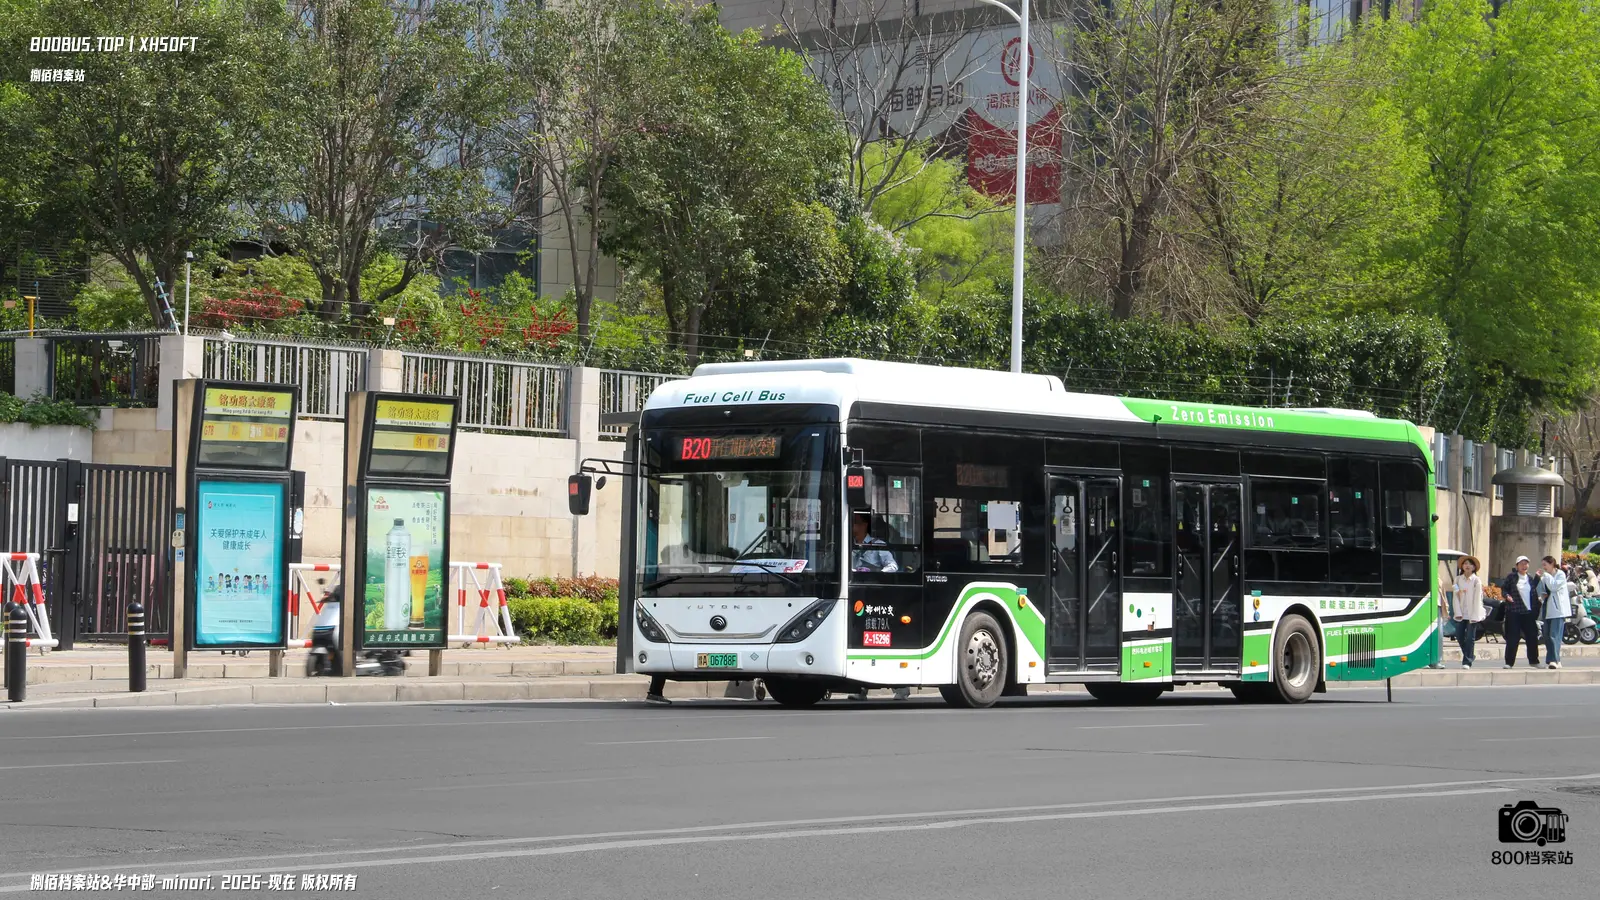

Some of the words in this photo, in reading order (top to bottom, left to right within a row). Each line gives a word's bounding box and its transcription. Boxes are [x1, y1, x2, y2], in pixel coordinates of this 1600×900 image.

[218, 393, 276, 409] 铭功路太康路
[683, 392, 717, 404] Fuel
[722, 390, 754, 402] Cell
[758, 390, 786, 401] Bus
[1170, 405, 1204, 423] Zero
[1207, 408, 1275, 428] Emission
[681, 437, 712, 460] B20
[848, 475, 864, 488] B20
[210, 528, 267, 540] 关爱保护未成年人
[222, 540, 251, 551] 健康成长
[865, 604, 895, 617] 郑州公交
[369, 633, 436, 642] 金星中式精酿啤酒
[864, 633, 890, 645] 2-15296
[1326, 629, 1343, 637] FUEL
[710, 655, 737, 667] 06788F
